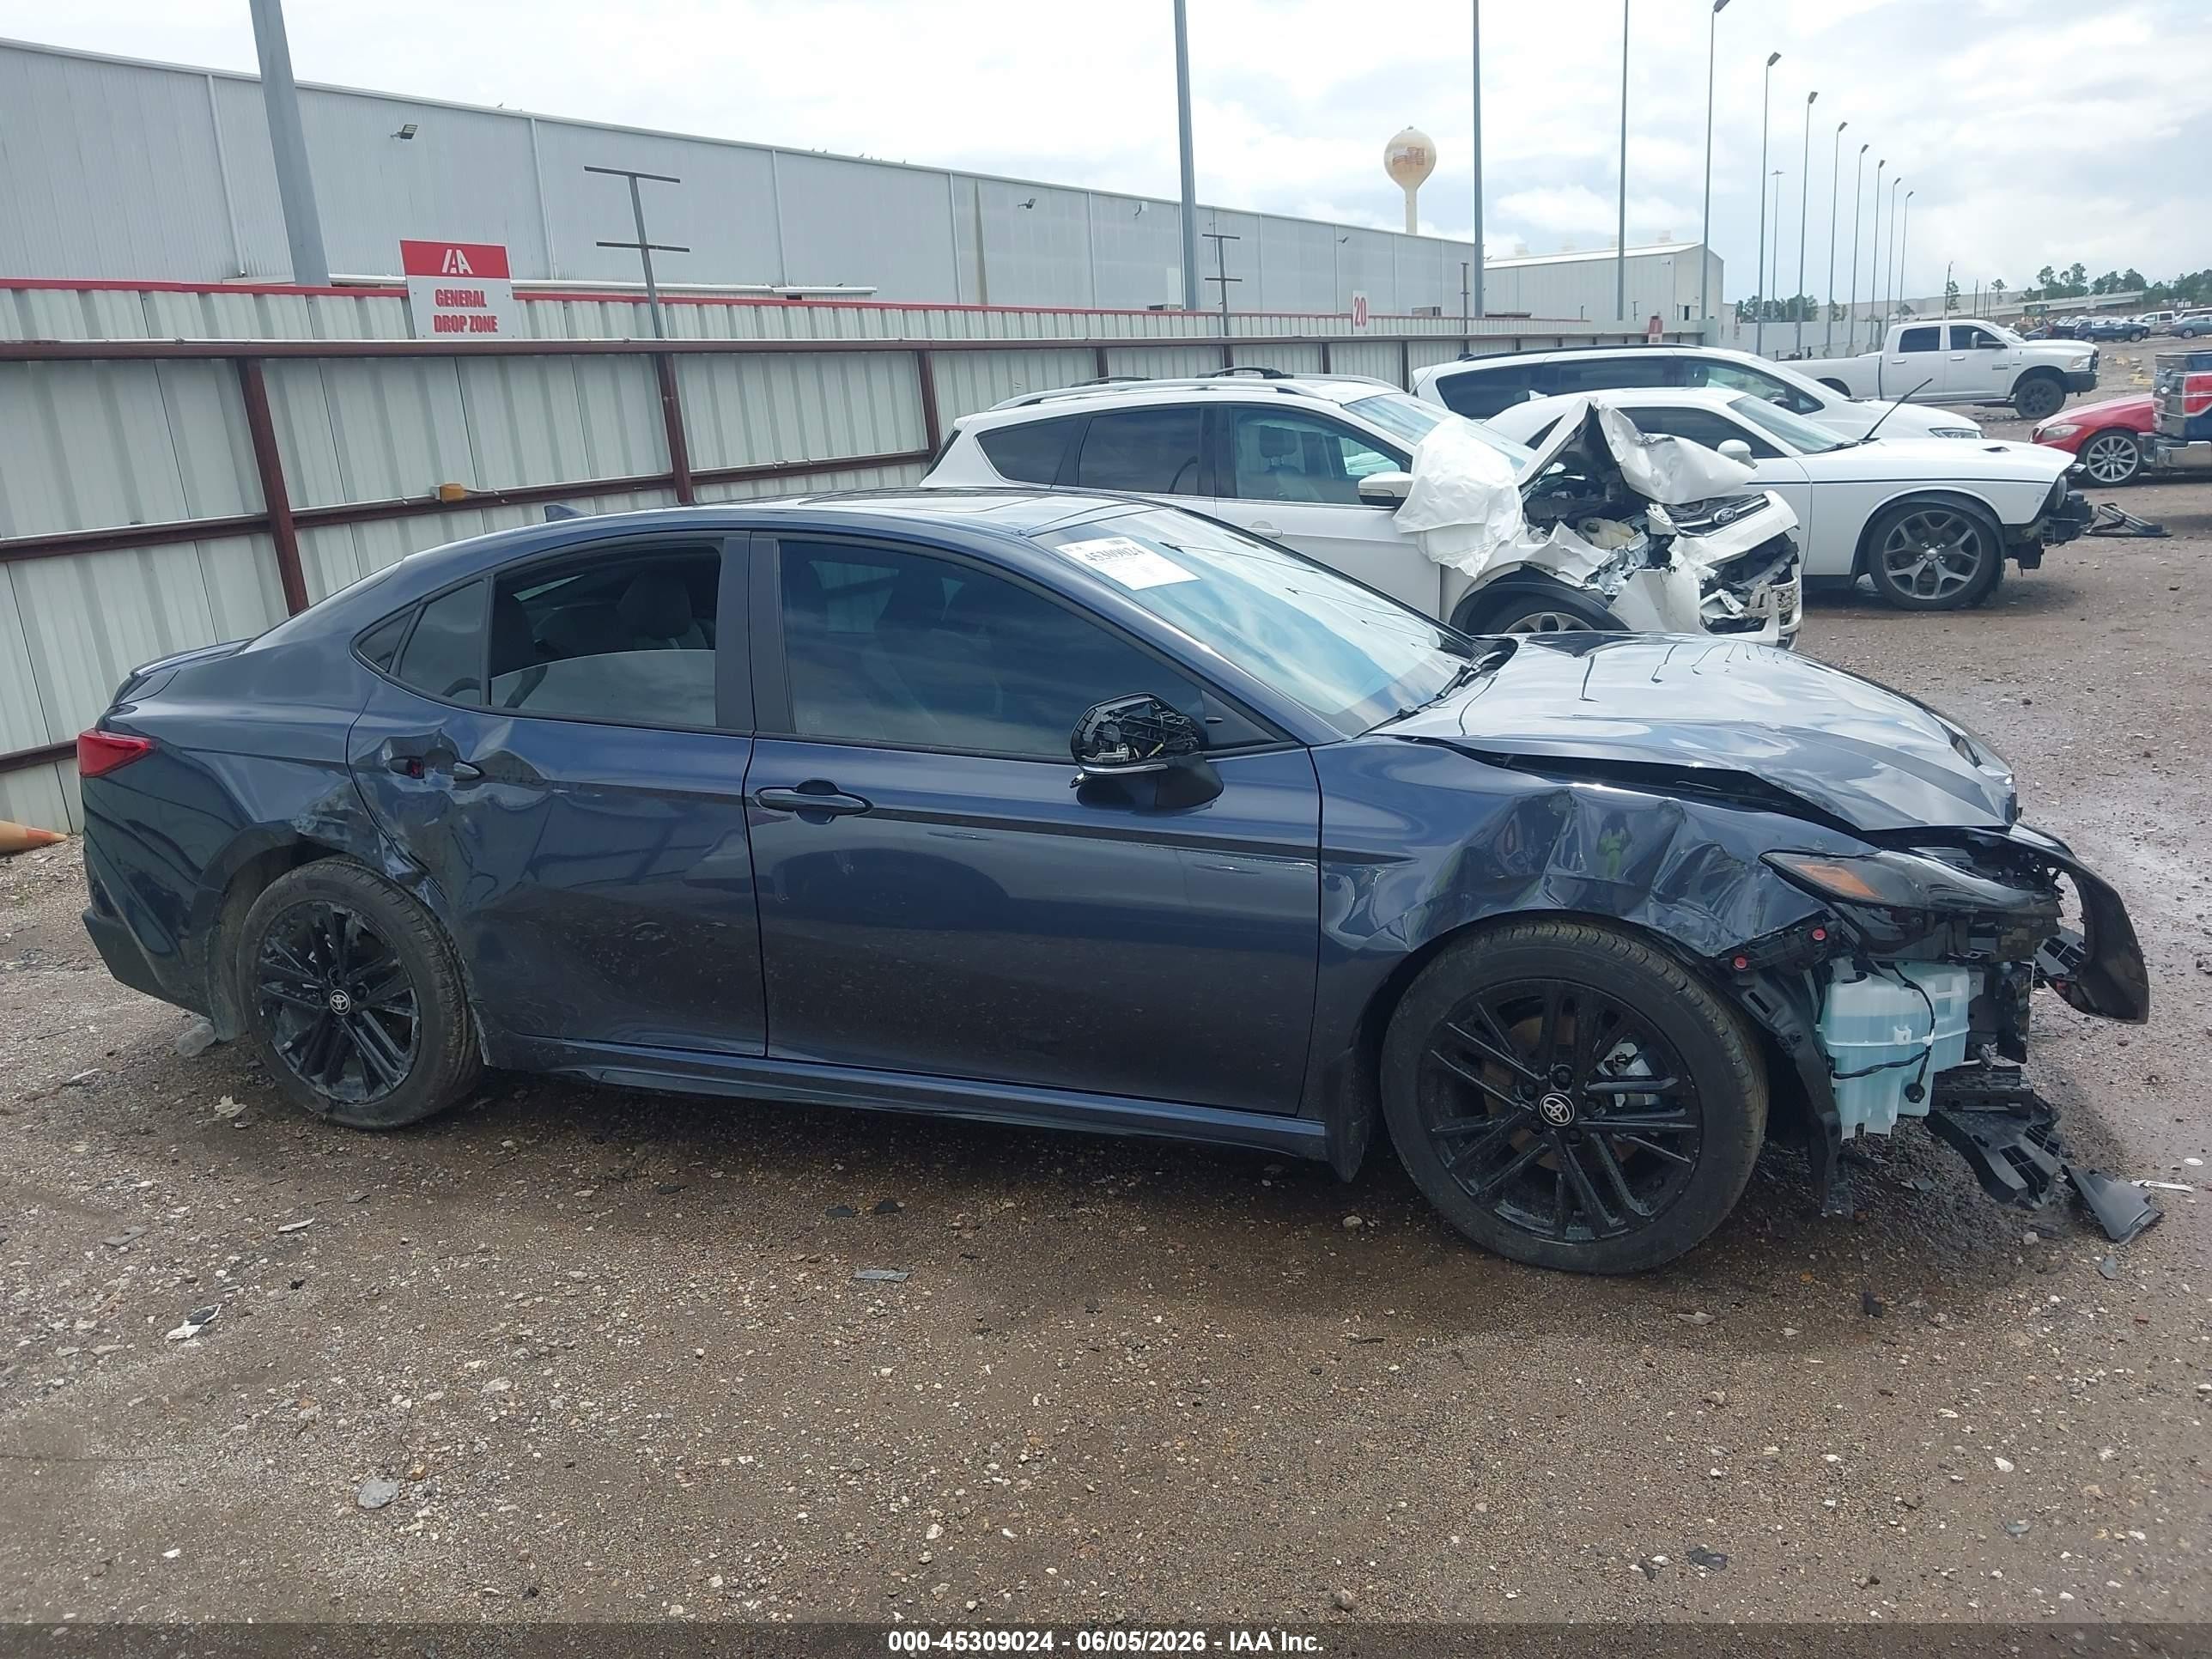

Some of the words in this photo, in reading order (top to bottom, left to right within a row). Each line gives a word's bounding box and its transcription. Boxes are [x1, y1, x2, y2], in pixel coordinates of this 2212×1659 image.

[434, 289, 487, 307] GENERAL
[1354, 296, 1366, 326] 20
[433, 314, 467, 332] DROP
[468, 315, 498, 332] ZONE
